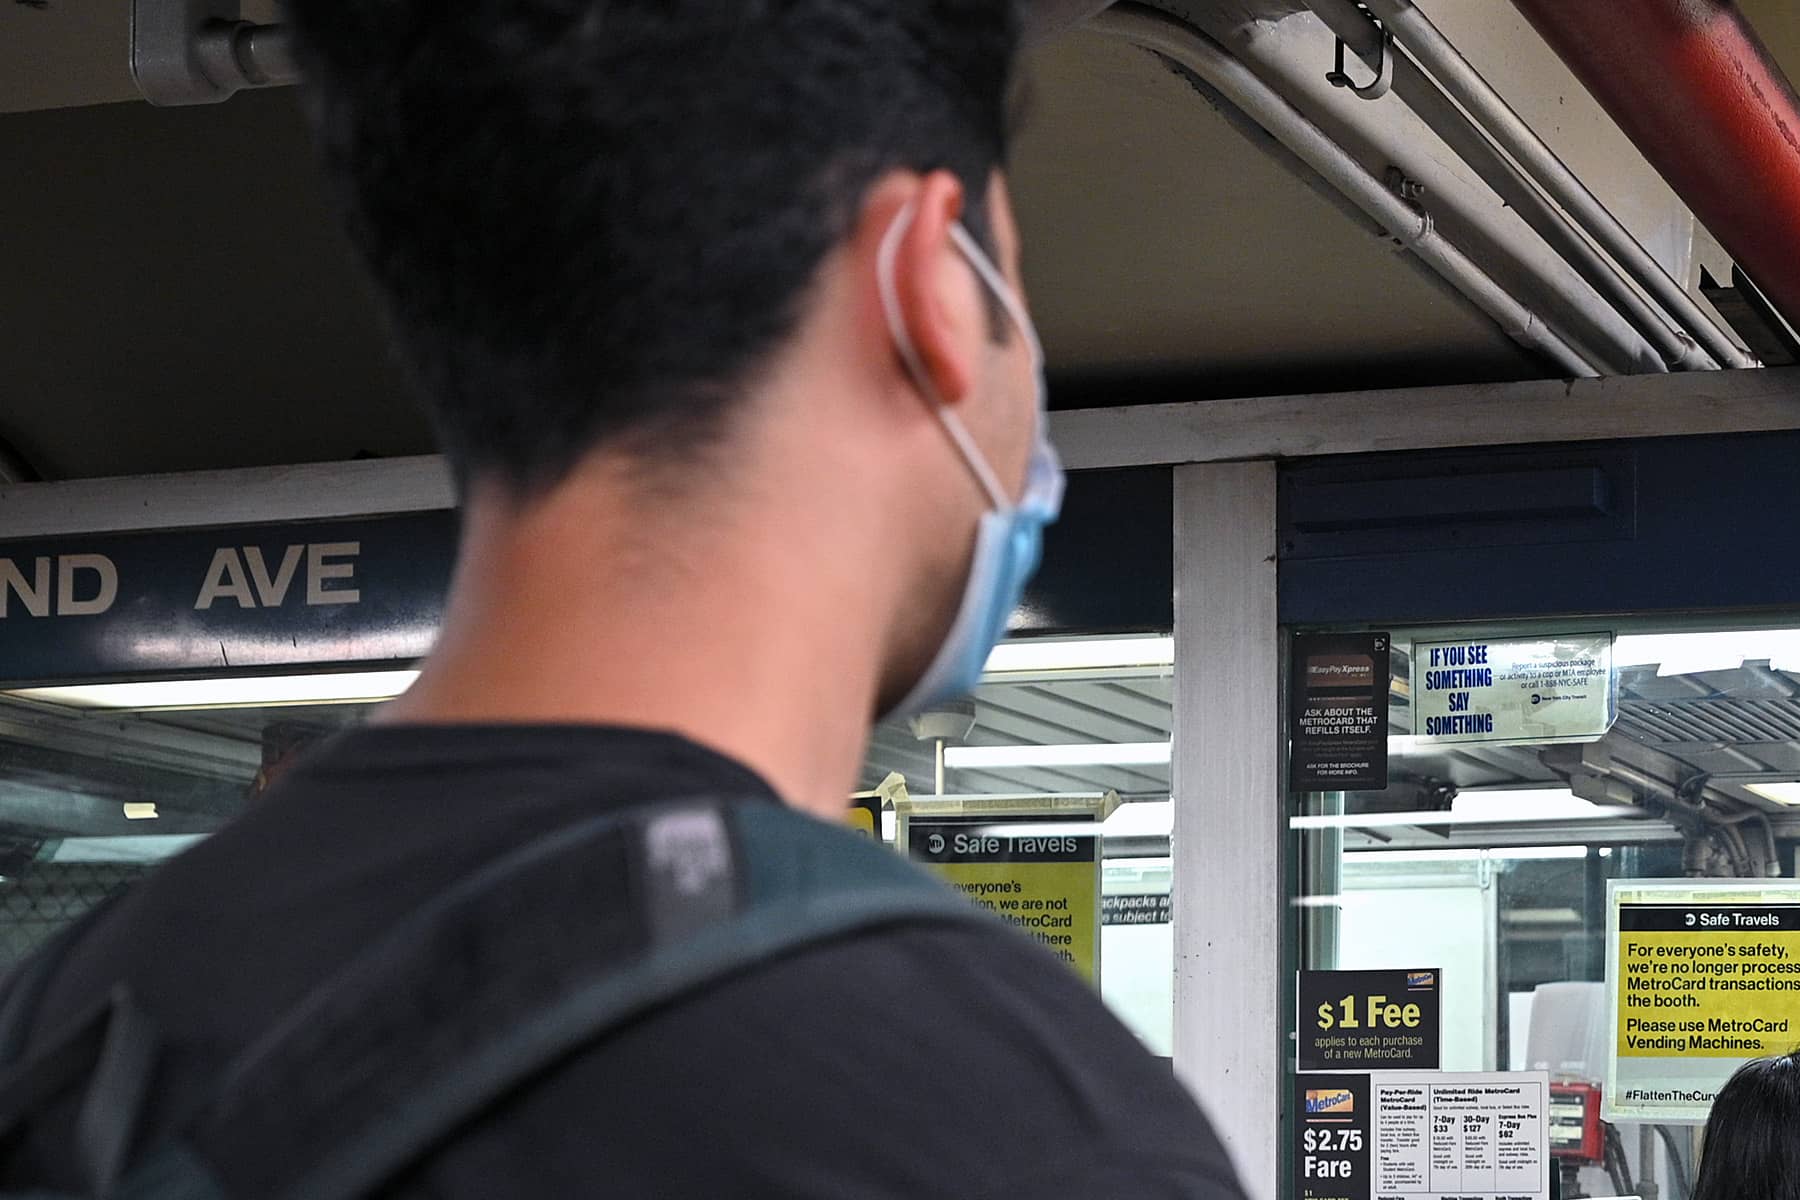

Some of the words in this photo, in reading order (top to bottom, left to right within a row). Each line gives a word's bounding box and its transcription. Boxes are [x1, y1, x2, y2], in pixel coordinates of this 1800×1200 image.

[194, 541, 361, 609] AVE
[1430, 648, 1440, 667] IF
[1442, 646, 1464, 666] YOU
[1467, 644, 1488, 665] SEE
[1511, 662, 1532, 671] Report
[1570, 658, 1595, 668] package
[1425, 667, 1492, 690] SOMETHING
[1528, 680, 1539, 688] call
[1448, 692, 1469, 712] SAY
[1304, 709, 1322, 717] ASK
[1323, 708, 1354, 717] ABOUT
[1355, 707, 1373, 716] THE
[1299, 717, 1354, 726] METROCARD
[1355, 716, 1378, 725] THAT
[1426, 713, 1493, 735] SOMETHING
[1305, 726, 1340, 735] REFILLS
[1341, 725, 1372, 734] ITSELF.
[953, 834, 999, 855] Safe
[1006, 834, 1078, 854] Travels
[999, 899, 1019, 910] we
[1022, 899, 1043, 910] are
[1046, 898, 1067, 910] not
[1699, 913, 1730, 926] Safe
[1732, 912, 1780, 926] Travels
[1627, 943, 1653, 957] For
[1656, 943, 1736, 959] everyone's
[1738, 943, 1789, 959] safety,
[1627, 960, 1668, 973] we're
[1671, 962, 1690, 973] no
[1692, 960, 1739, 976] longer
[1627, 976, 1706, 991] MetroCard
[1709, 976, 1800, 990] transactions
[1627, 994, 1651, 1007] the
[1654, 994, 1700, 1008] booth.
[1317, 995, 1359, 1032] $1
[1367, 995, 1421, 1028] Fee
[1627, 1018, 1676, 1032] Please
[1679, 1021, 1704, 1032] use
[1708, 1018, 1789, 1032] MetroCard
[1314, 1035, 1346, 1048] applies
[1348, 1036, 1356, 1047] to
[1359, 1035, 1380, 1047] each
[1382, 1035, 1423, 1048] purchase
[1626, 1035, 1686, 1051] Vending
[1689, 1034, 1765, 1049] Machines.
[1324, 1049, 1334, 1060] of
[1335, 1051, 1341, 1059] a
[1343, 1051, 1361, 1059] new
[1364, 1047, 1414, 1059] MetroCard.
[1484, 1087, 1521, 1095] MetroCard
[1625, 1090, 1719, 1102] #FlattenTheCurv
[1433, 1096, 1478, 1104] (Time-Based)
[1433, 1115, 1456, 1125] 7-Day
[1463, 1115, 1490, 1124] 30-Day
[1498, 1120, 1521, 1130] 7-Day
[1433, 1124, 1449, 1133] $33
[1463, 1124, 1482, 1133] $127
[1303, 1127, 1363, 1154] $2.75
[1304, 1155, 1352, 1179] Fare
